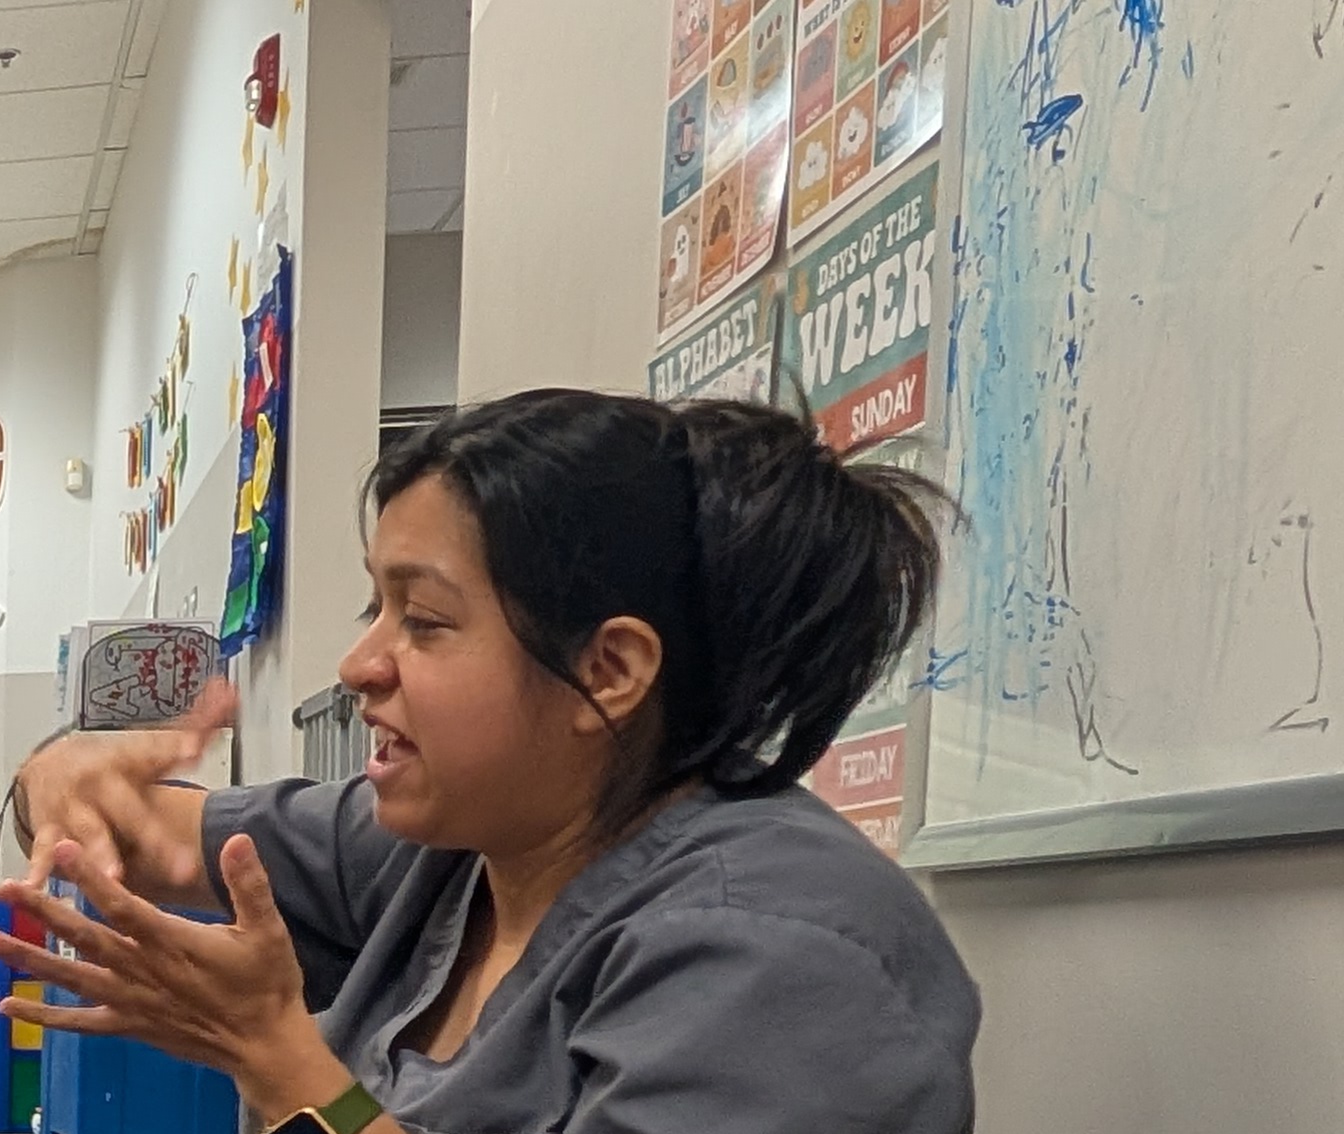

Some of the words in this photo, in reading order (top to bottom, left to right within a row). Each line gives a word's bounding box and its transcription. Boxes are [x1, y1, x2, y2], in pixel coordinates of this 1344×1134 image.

[817, 241, 858, 296] DAYS
[860, 224, 885, 267] OF
[885, 195, 922, 248] THE
[654, 300, 758, 400] ALPHABET
[800, 229, 936, 396] WEEK
[850, 374, 917, 443] SUNDAY
[840, 744, 898, 787] FRIDAY
